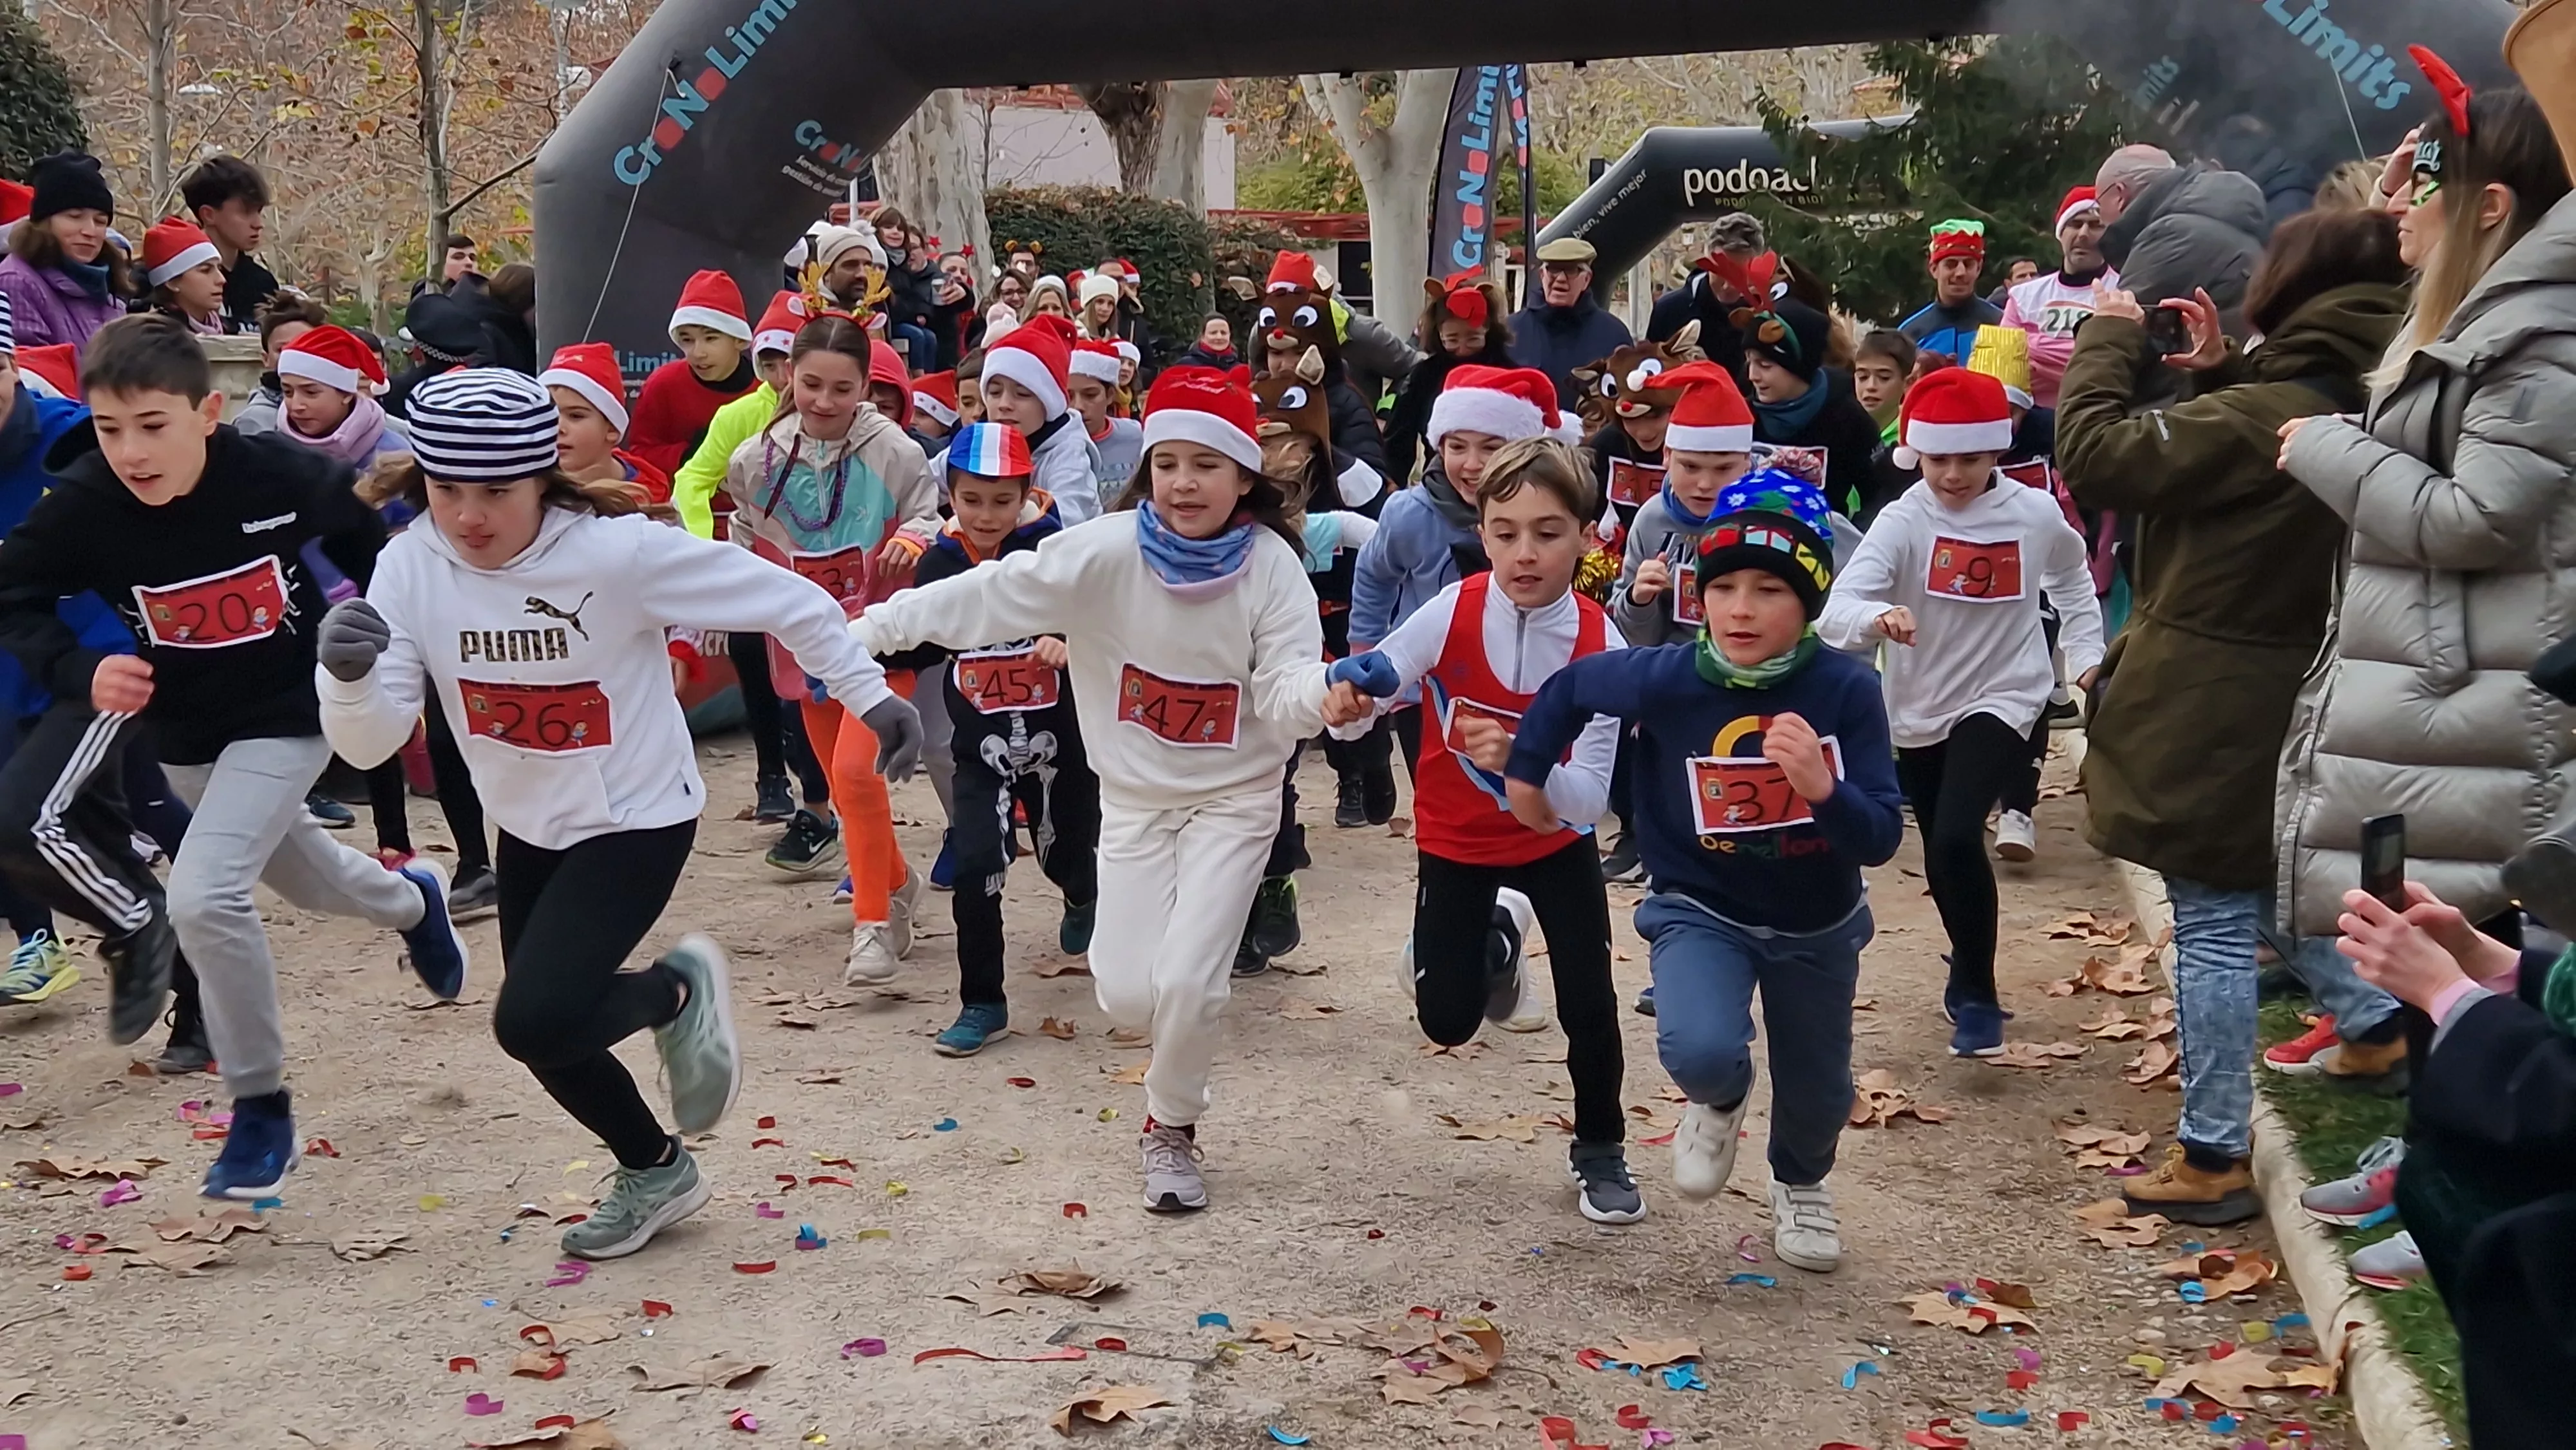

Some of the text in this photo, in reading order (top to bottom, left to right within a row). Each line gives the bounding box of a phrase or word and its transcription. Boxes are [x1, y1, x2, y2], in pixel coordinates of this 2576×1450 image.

[1597, 197, 1618, 217] vive
[1618, 169, 1647, 200] mejor
[807, 568, 845, 599] 3
[1965, 556, 1993, 598] 9
[178, 592, 251, 641] 20
[459, 628, 569, 663] PUMA
[981, 668, 1032, 704] 45
[495, 701, 572, 747] 26
[1144, 695, 1206, 739] 47
[1727, 777, 1794, 823] 37
